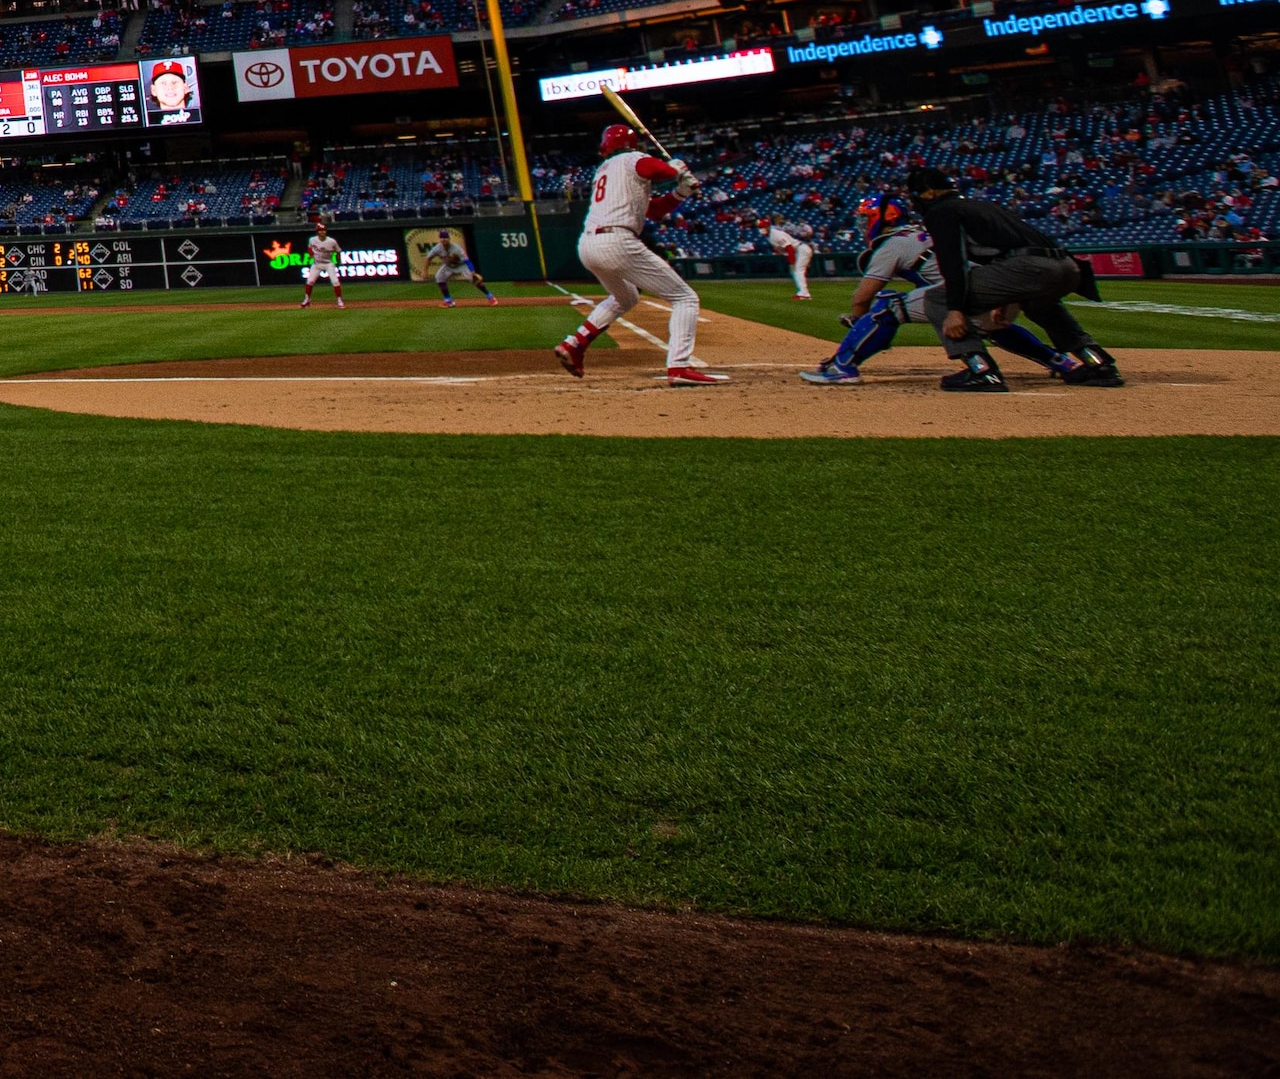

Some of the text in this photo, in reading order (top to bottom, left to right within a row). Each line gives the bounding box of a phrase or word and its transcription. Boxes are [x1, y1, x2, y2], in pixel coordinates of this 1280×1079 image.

[787, 31, 918, 64] Independence
[983, 1, 1139, 38] Independence
[299, 50, 444, 84] TOYOTA
[43, 72, 88, 83] ALEC BOHM
[72, 85, 134, 97] AVG OBP SLG
[544, 75, 615, 96] ibx.com
[53, 108, 114, 120] HR RBI BB%
[121, 114, 138, 123] 25.5
[501, 232, 528, 248] 330
[27, 245, 46, 255] CHC
[76, 241, 131, 253] 55 COL
[30, 257, 45, 266] CIN
[116, 253, 132, 264] ARI
[119, 267, 130, 277] SF
[120, 280, 133, 290] SD
